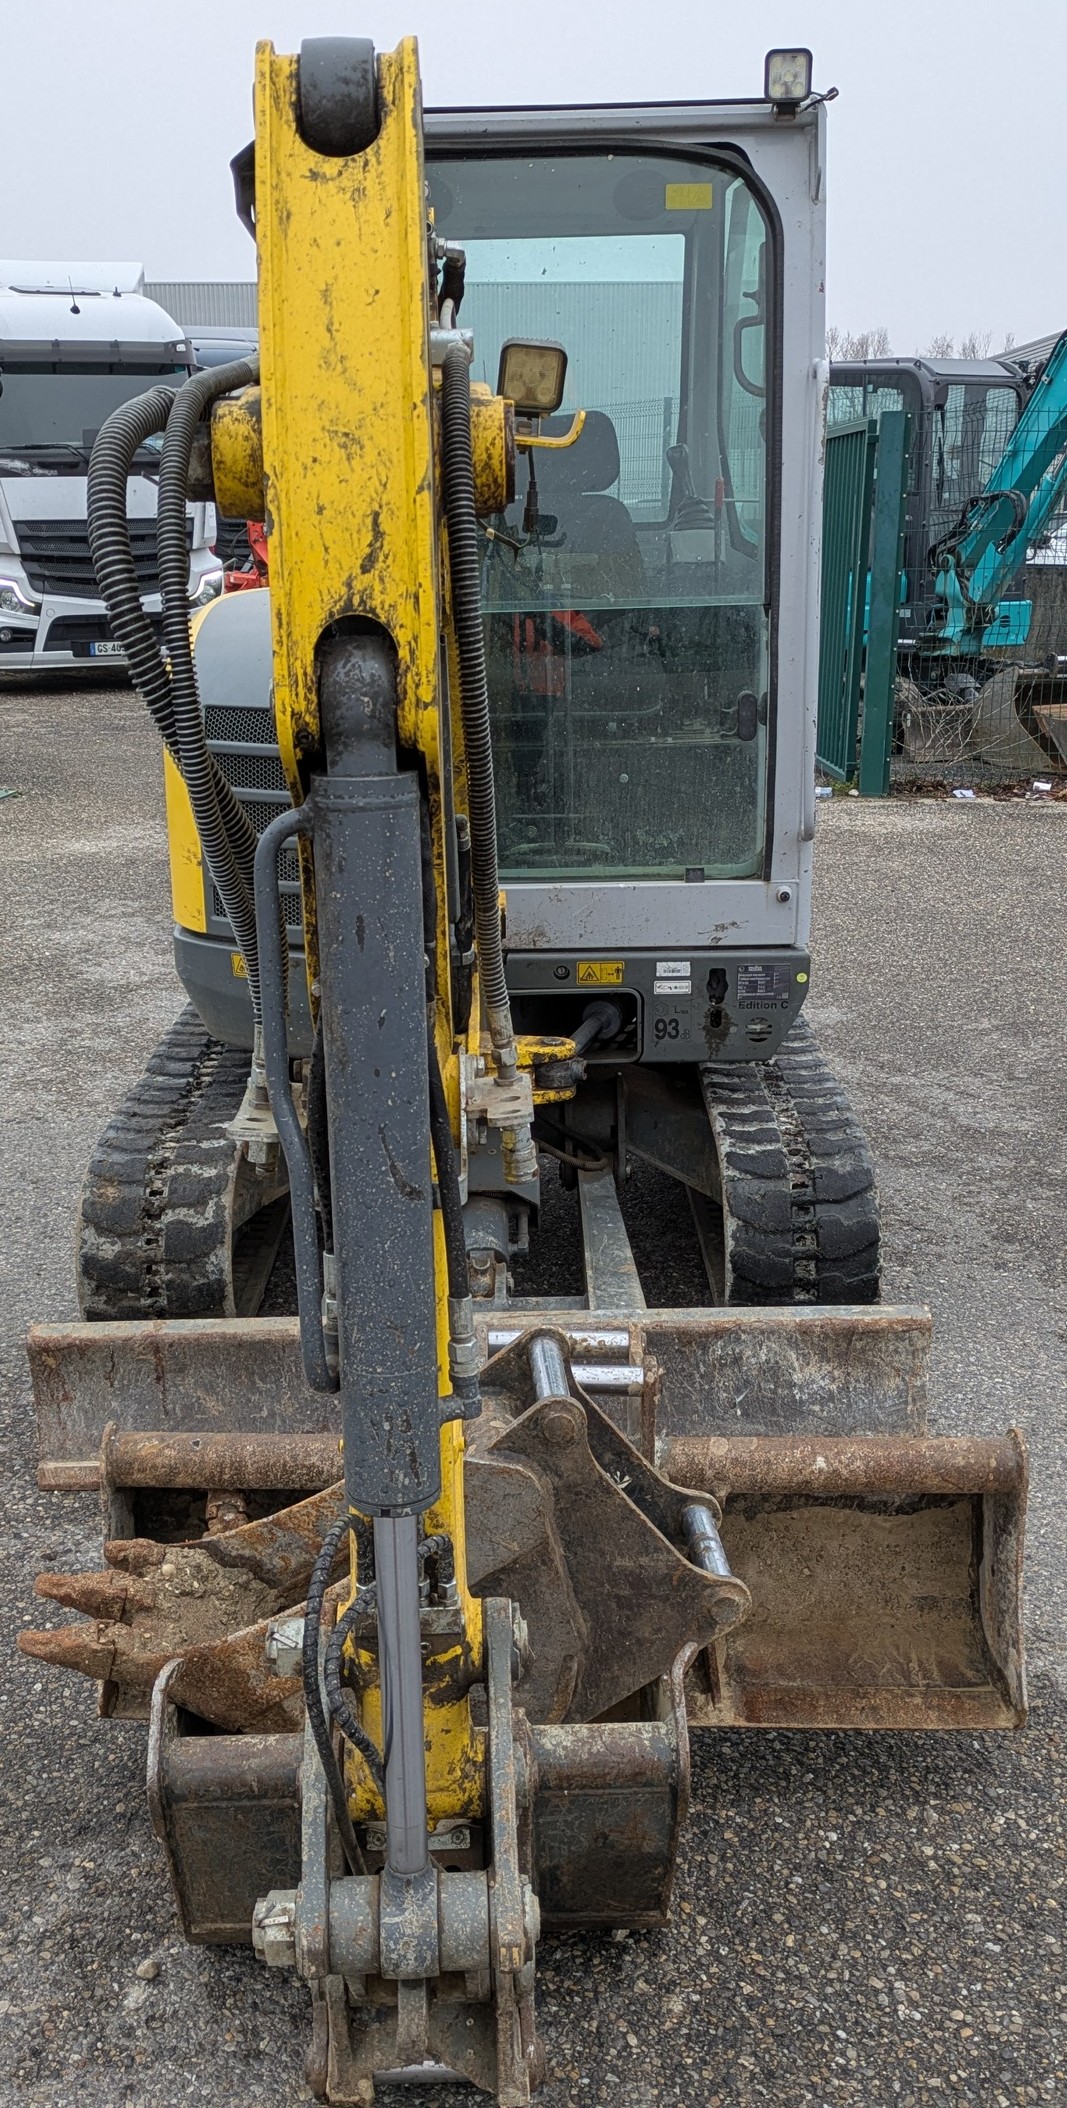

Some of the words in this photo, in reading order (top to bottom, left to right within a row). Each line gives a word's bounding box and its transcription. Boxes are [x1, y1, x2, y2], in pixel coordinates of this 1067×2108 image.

[738, 1001, 777, 1010] Edition
[780, 1001, 789, 1009] C
[654, 1018, 680, 1040] 93
